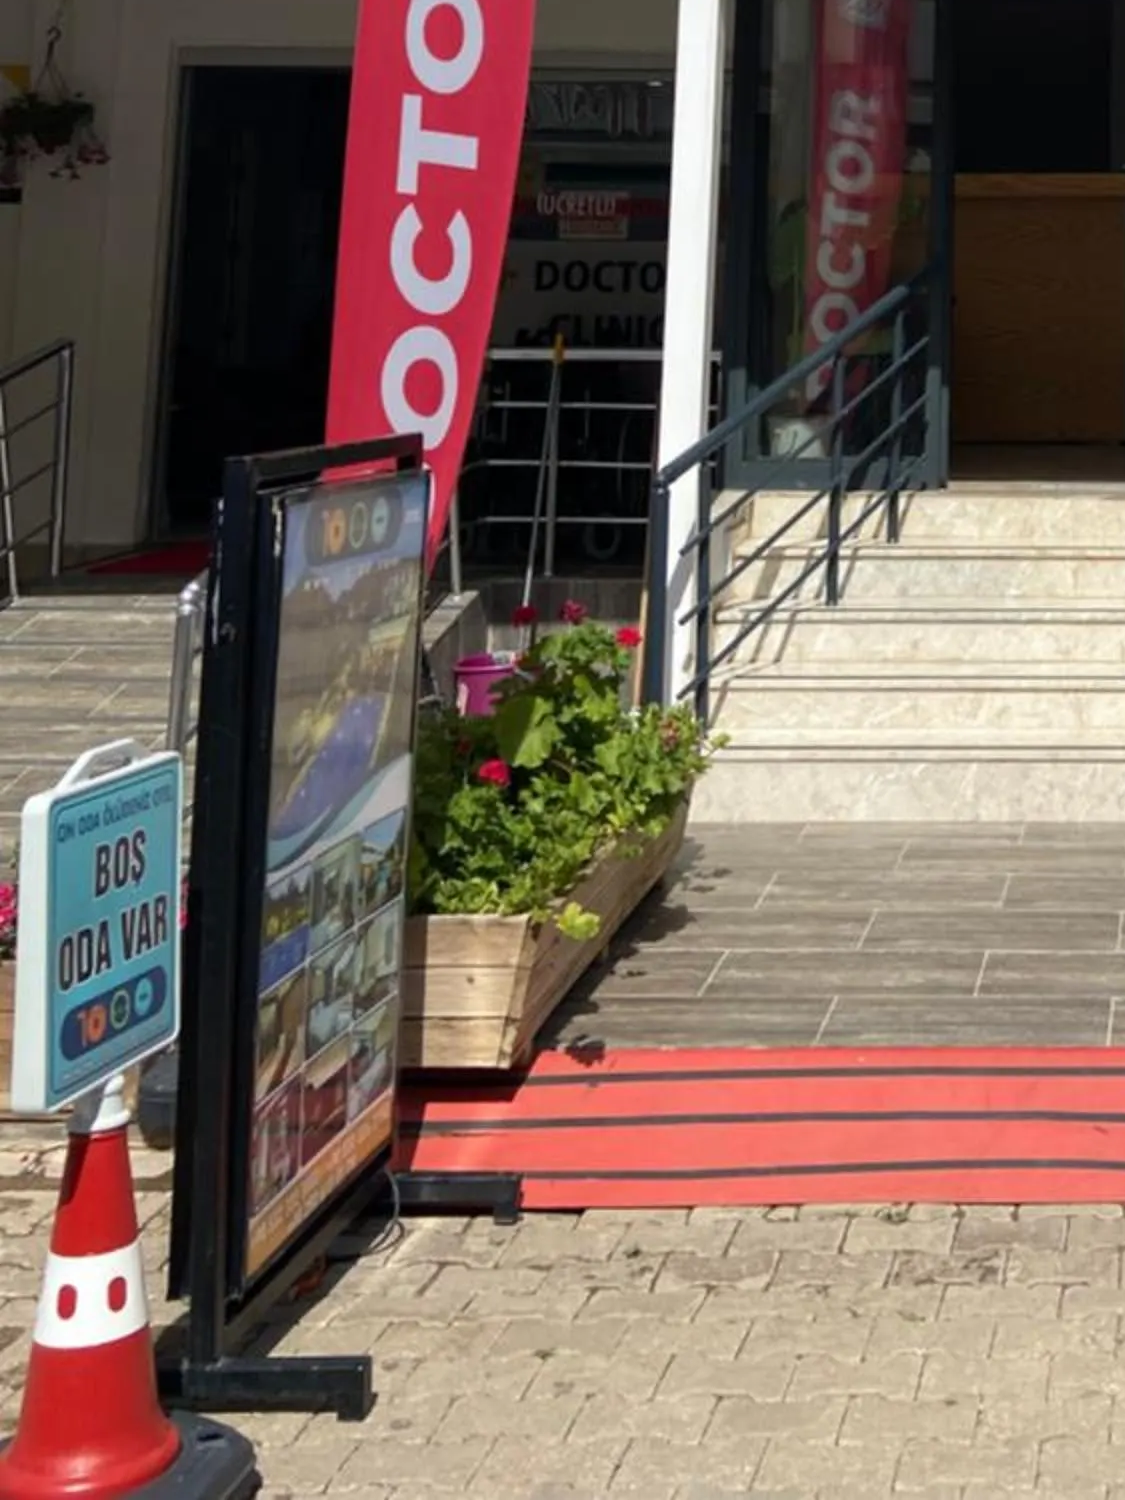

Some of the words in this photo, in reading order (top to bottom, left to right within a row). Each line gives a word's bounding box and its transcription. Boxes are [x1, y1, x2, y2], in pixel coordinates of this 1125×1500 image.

[535, 259, 666, 294] DOCTO
[59, 920, 113, 992] ODA
[121, 894, 168, 961] VAR
